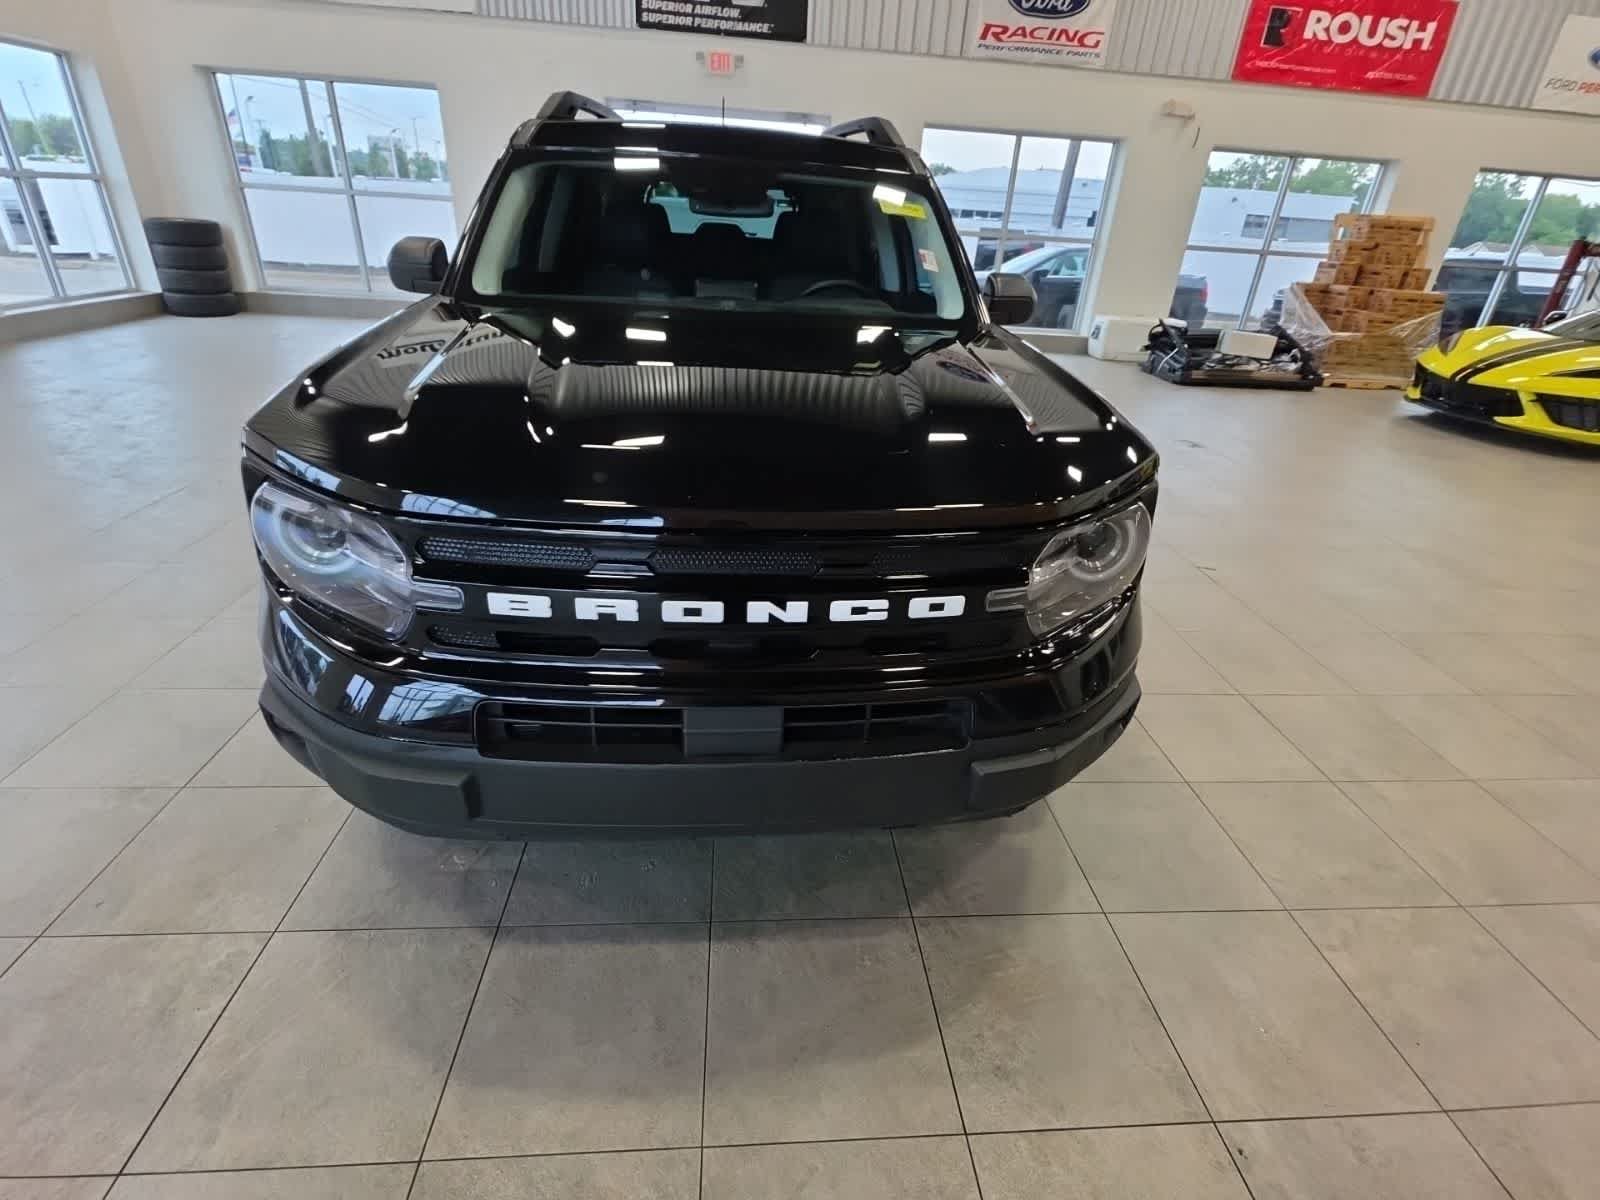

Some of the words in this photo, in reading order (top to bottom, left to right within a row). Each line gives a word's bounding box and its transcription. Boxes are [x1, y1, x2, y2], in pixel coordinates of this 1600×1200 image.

[641, 0, 693, 14] SUPERIOR
[694, 5, 742, 19] AIRFLOW.
[641, 12, 693, 27] SUPERIOR
[979, 23, 1105, 49] RACING
[1304, 9, 1438, 51] ROUSH
[978, 43, 1063, 56] PERFORMANCE
[1066, 51, 1101, 59] PARTS
[486, 592, 966, 623] BRONCO
